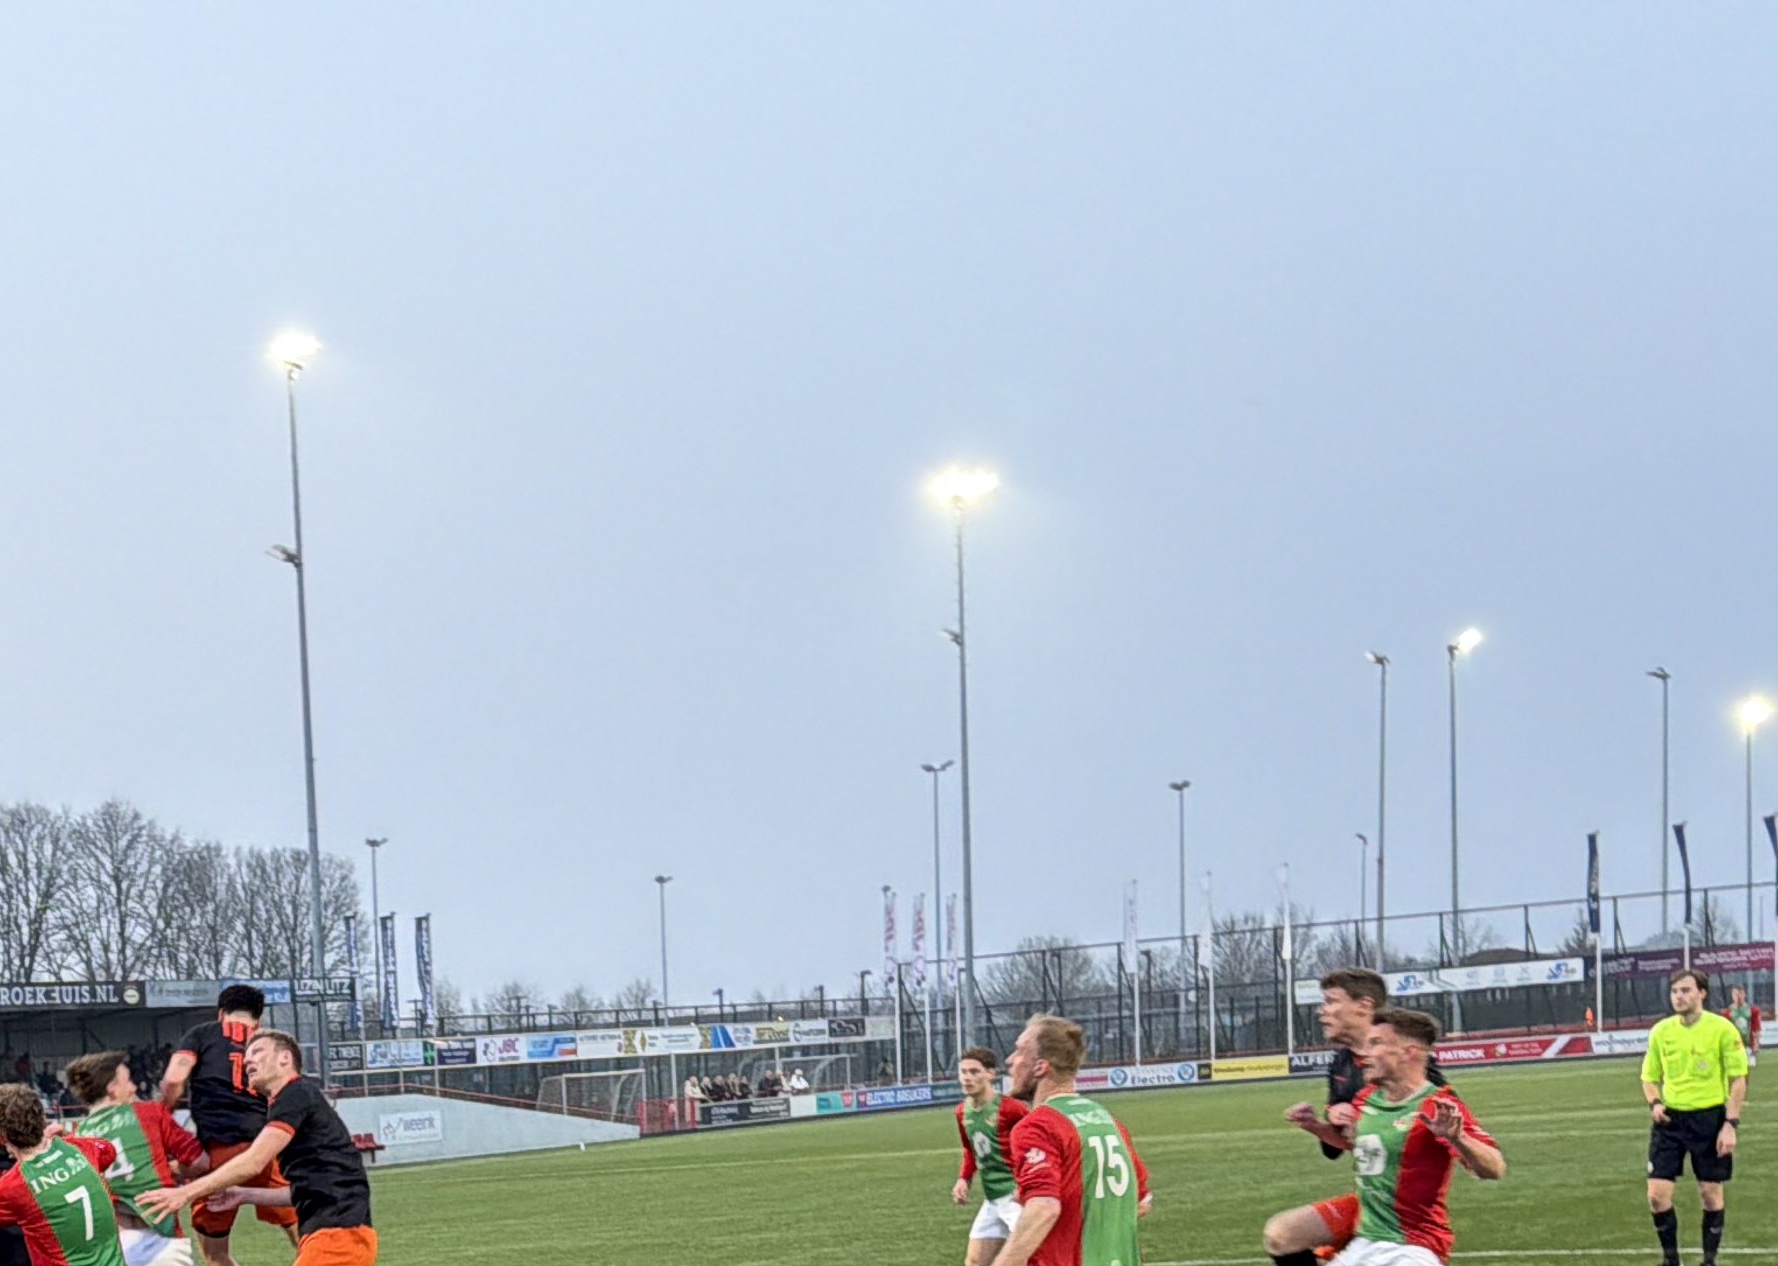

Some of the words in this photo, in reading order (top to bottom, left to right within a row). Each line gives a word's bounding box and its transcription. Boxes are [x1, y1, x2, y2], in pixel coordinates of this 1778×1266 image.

[30, 1168, 70, 1195] ING
[1088, 1135, 1129, 1199] 15
[64, 1185, 93, 1241] 7
